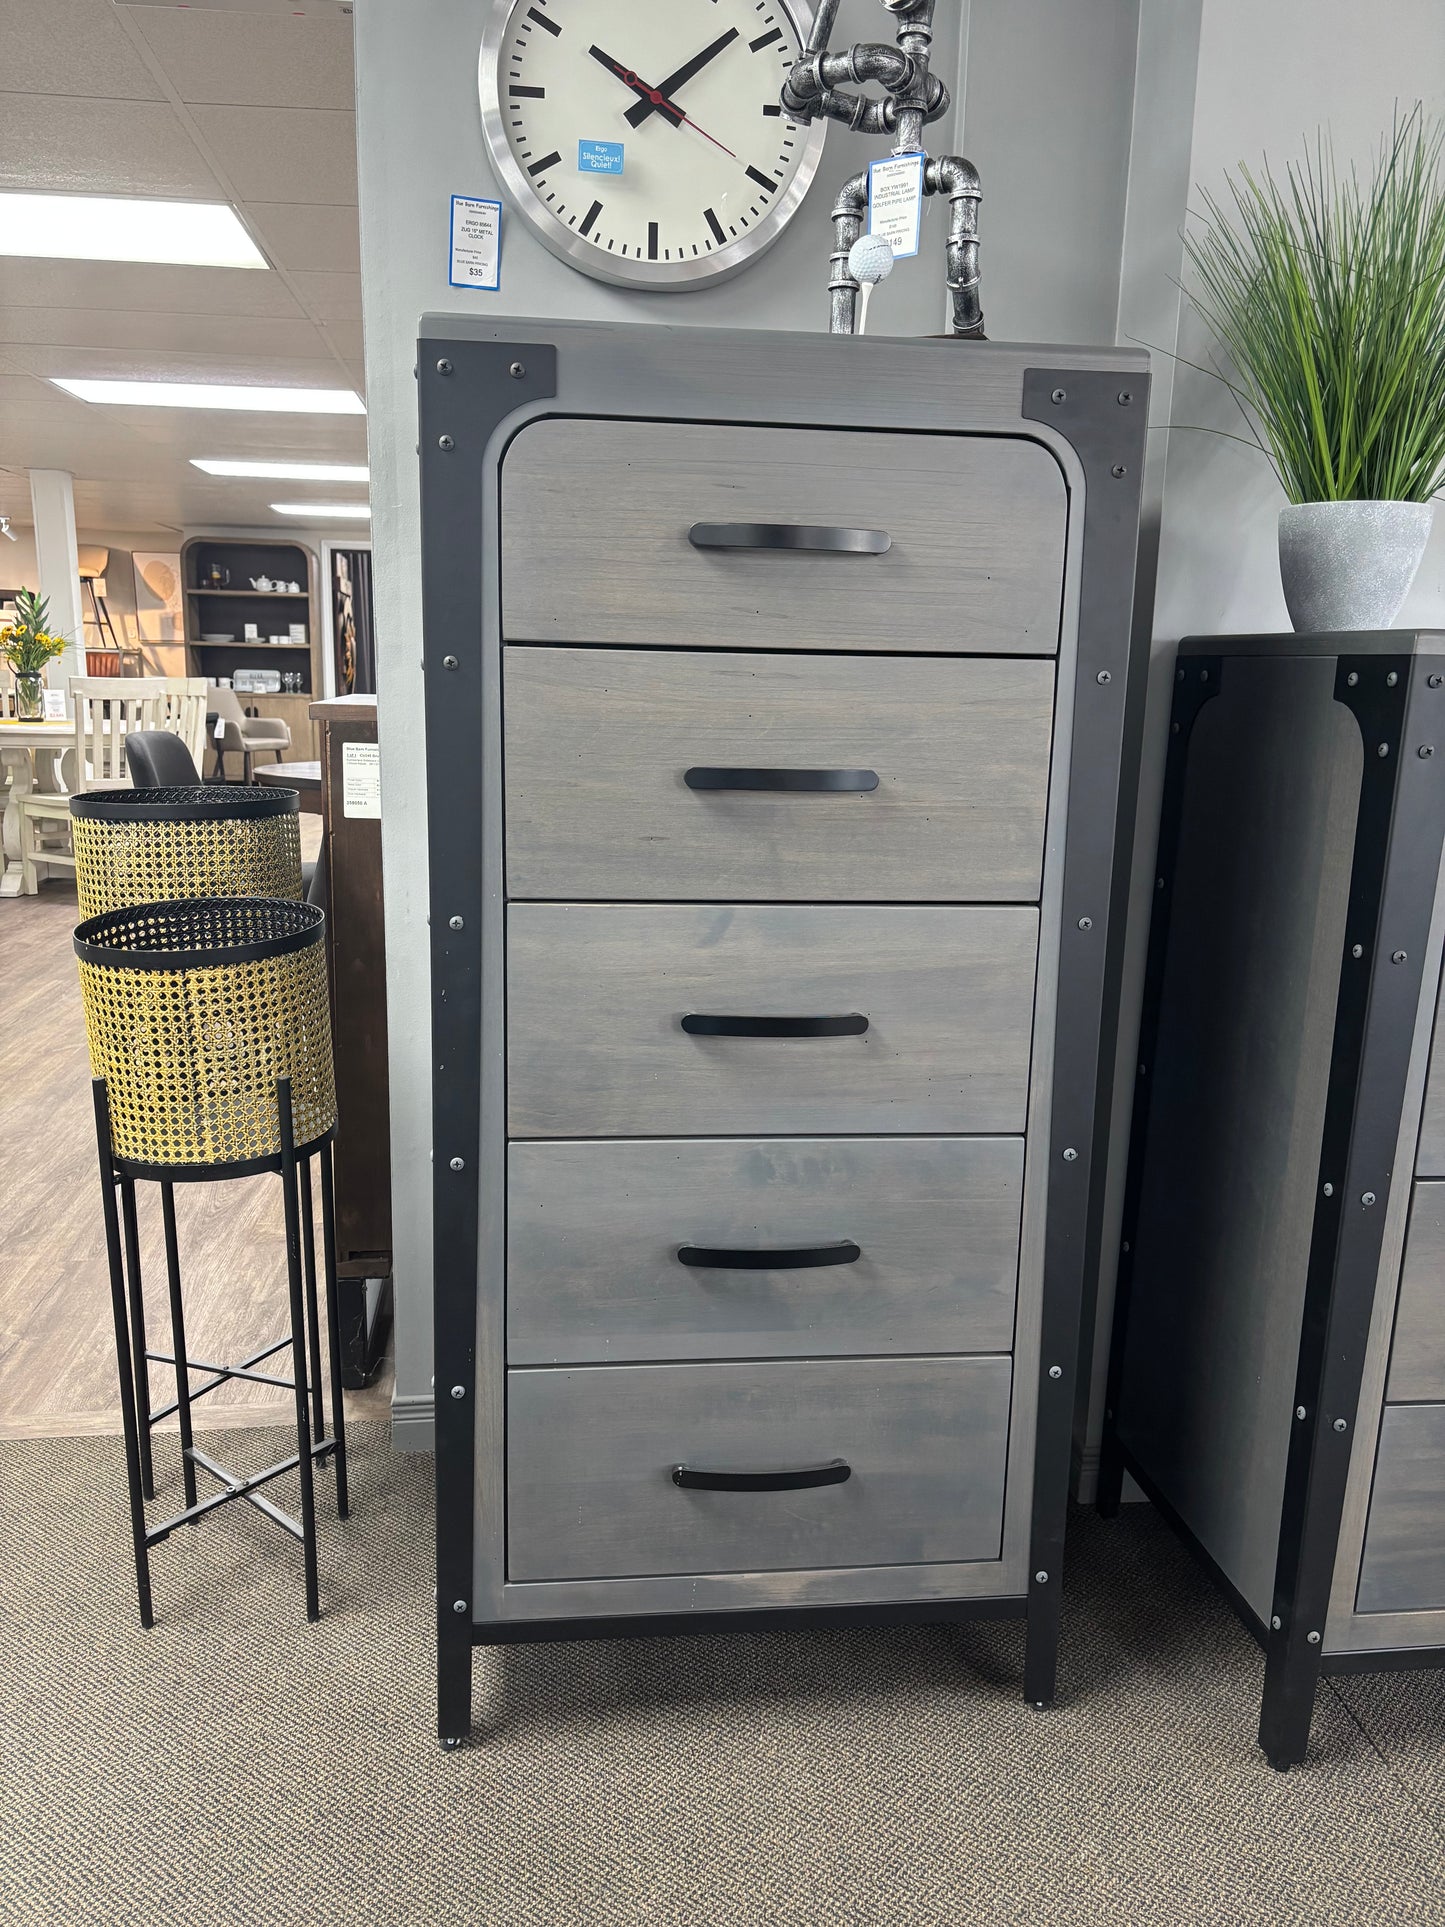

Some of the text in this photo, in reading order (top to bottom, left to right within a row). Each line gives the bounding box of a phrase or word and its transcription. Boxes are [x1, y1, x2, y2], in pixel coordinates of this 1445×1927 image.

[595, 145, 608, 153] Ergo
[582, 152, 621, 163] Silencieux!
[590, 160, 612, 169] Quiet!
[874, 191, 901, 200] INDUSTRIAL
[469, 268, 483, 276] $35
